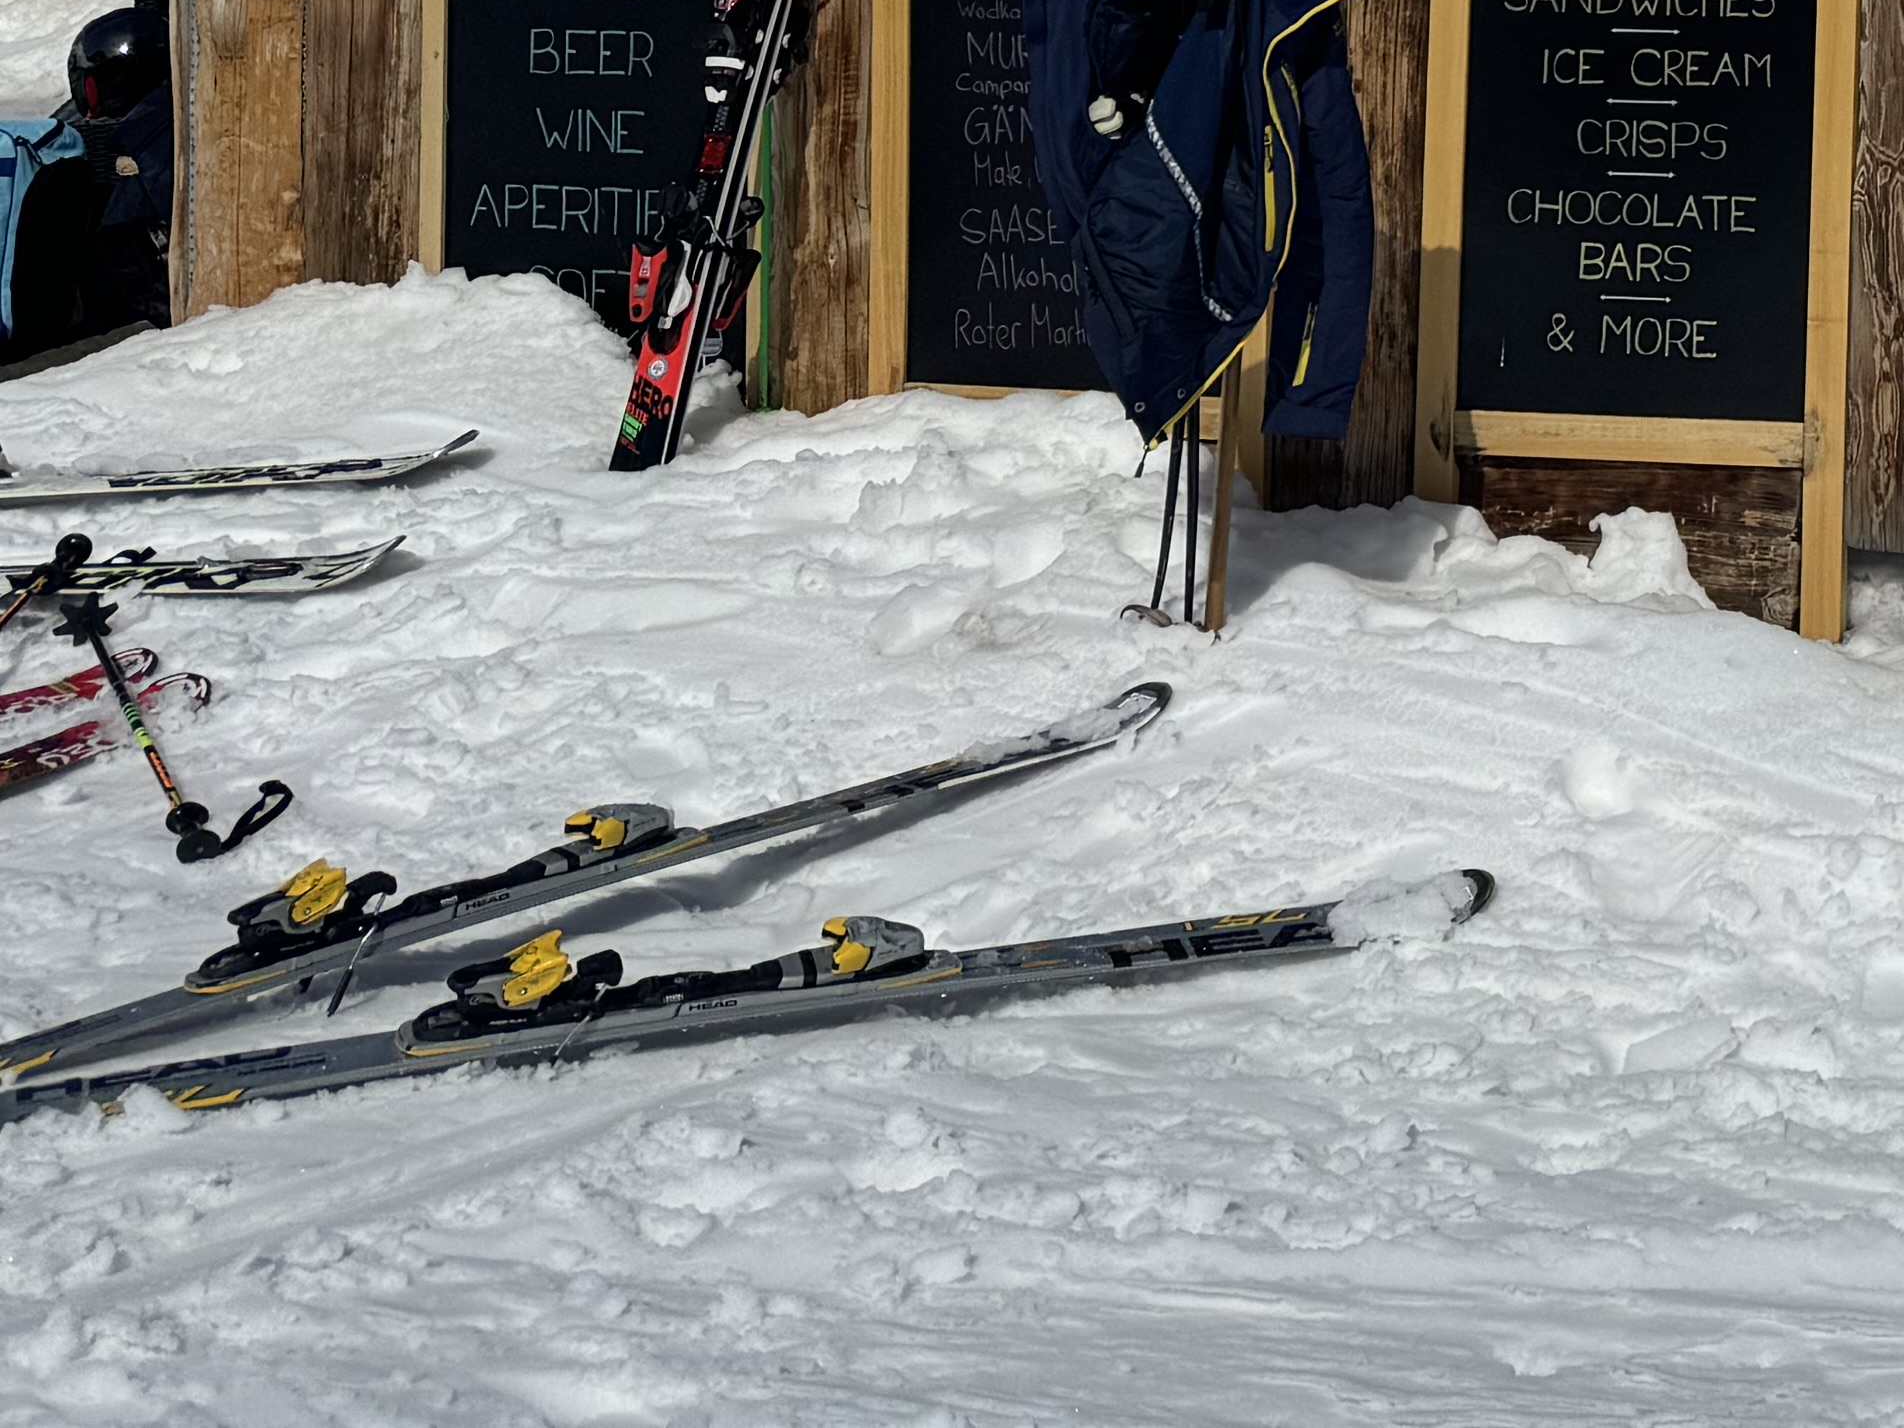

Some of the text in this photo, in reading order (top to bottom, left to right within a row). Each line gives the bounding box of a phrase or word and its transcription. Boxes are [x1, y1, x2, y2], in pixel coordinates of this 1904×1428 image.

[957, 0, 1021, 20] Wodka
[529, 28, 654, 77] BEER
[1542, 48, 1772, 88] ICE CREAM
[536, 108, 644, 155] WINE
[1576, 118, 1729, 160] CRISPS
[470, 183, 661, 236] APERITIF
[1507, 188, 1757, 233] CHOCOLATE
[976, 251, 1080, 296] Alkohol
[1578, 242, 1692, 282] BARS
[955, 301, 1023, 350] Roter
[1546, 312, 1717, 359] & MORE
[630, 375, 675, 421] HERO
[464, 892, 511, 911] HEAD
[1106, 922, 1334, 968] HEA
[687, 998, 738, 1013] HEAD
